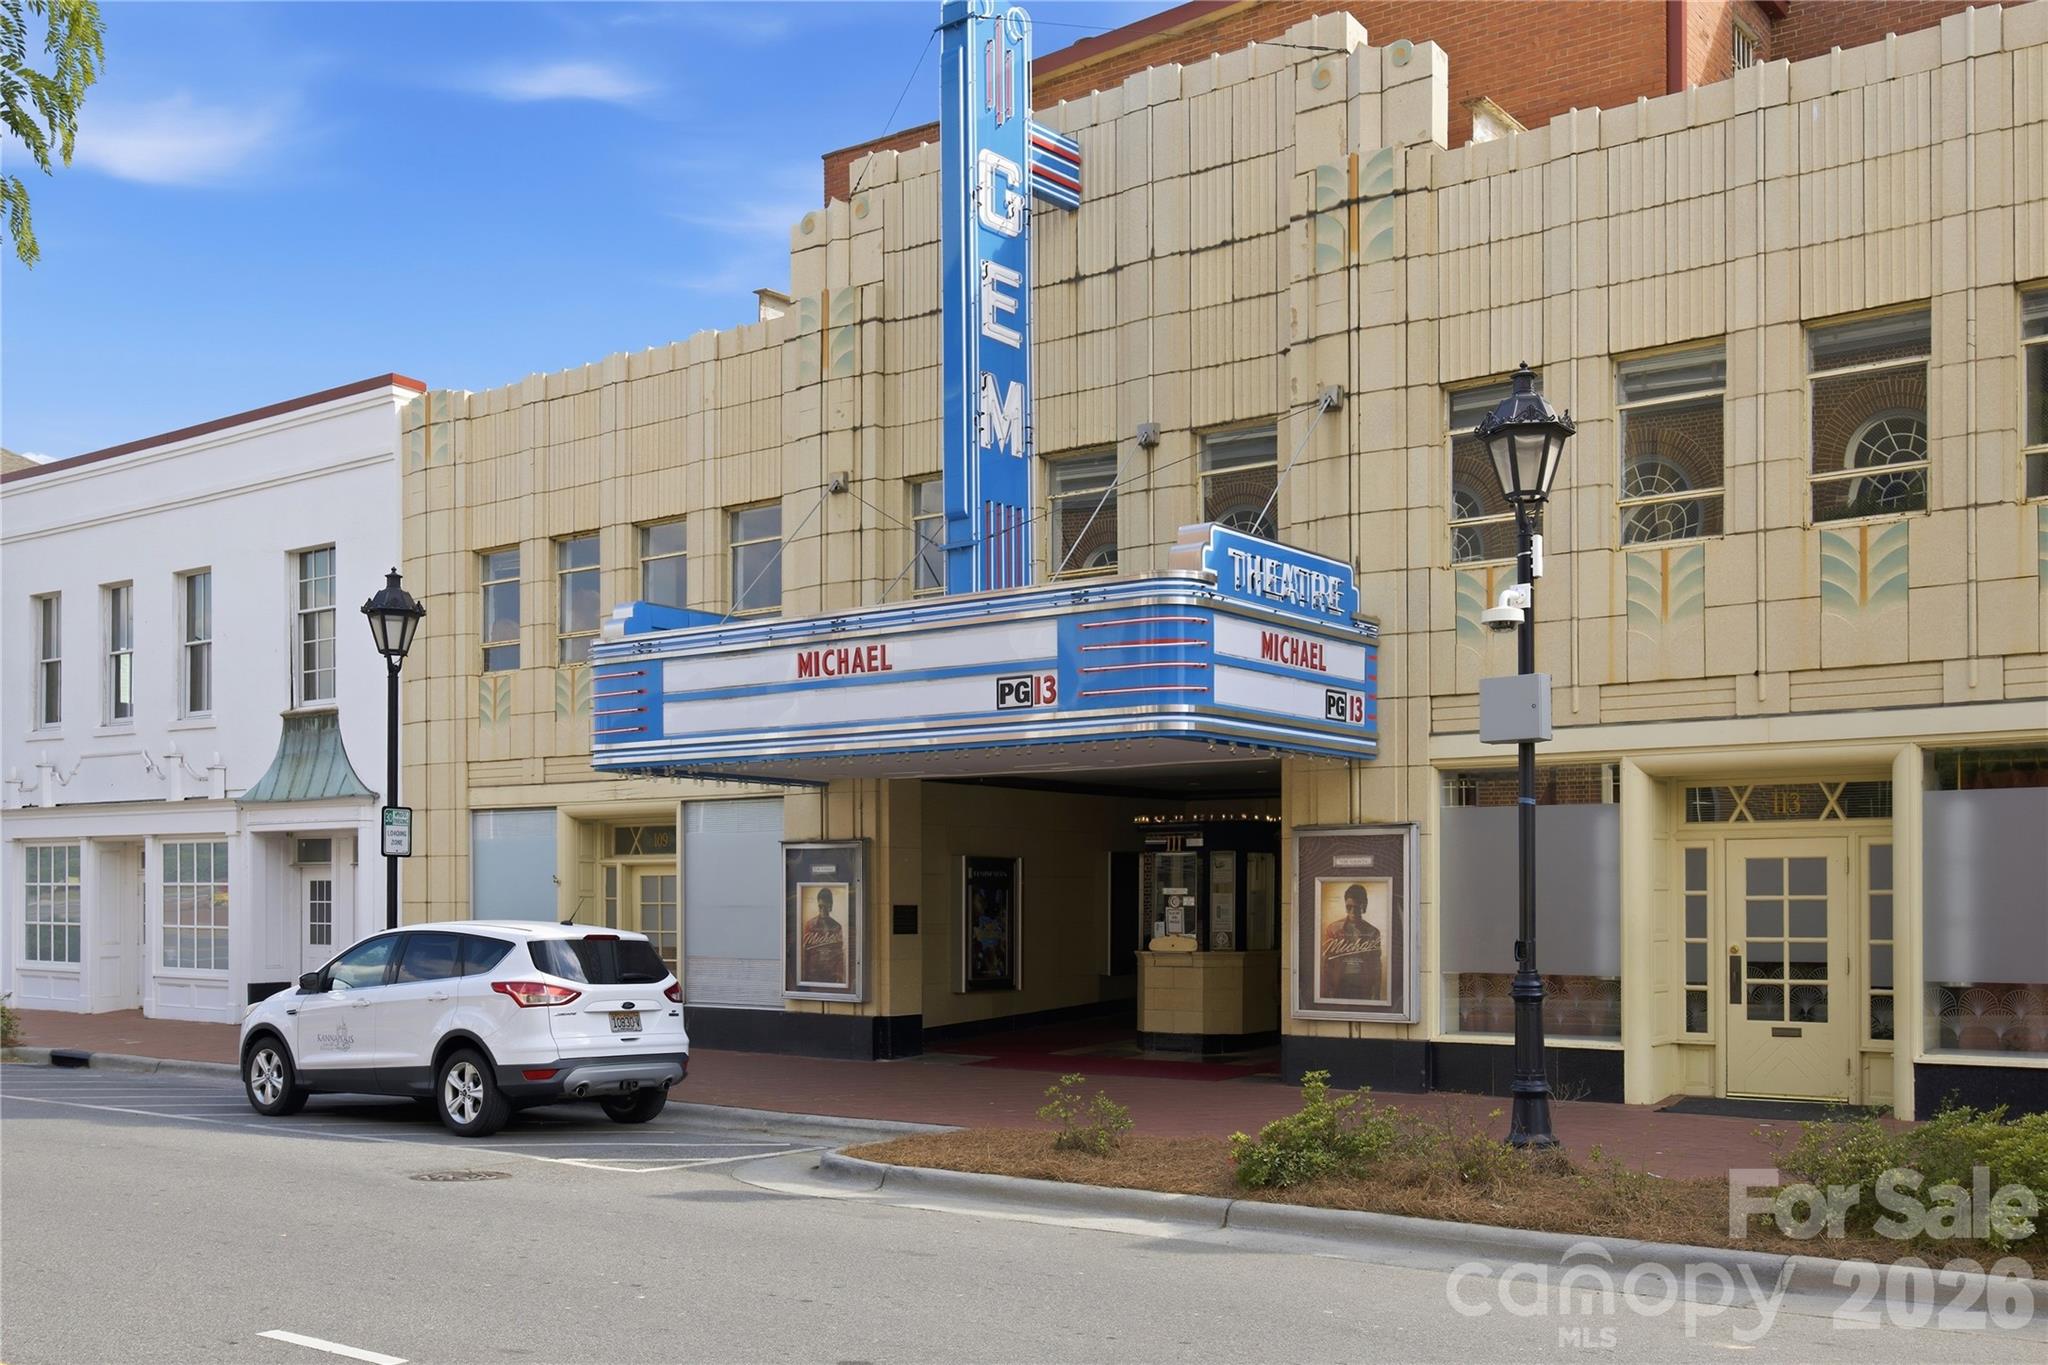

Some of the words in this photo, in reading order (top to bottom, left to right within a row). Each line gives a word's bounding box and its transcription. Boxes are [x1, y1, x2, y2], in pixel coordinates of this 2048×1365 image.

[978, 148, 1025, 458] GEM
[1227, 547, 1344, 617] THEATRE
[797, 644, 893, 679] MICHAEL
[1261, 631, 1327, 672] MICHAEL
